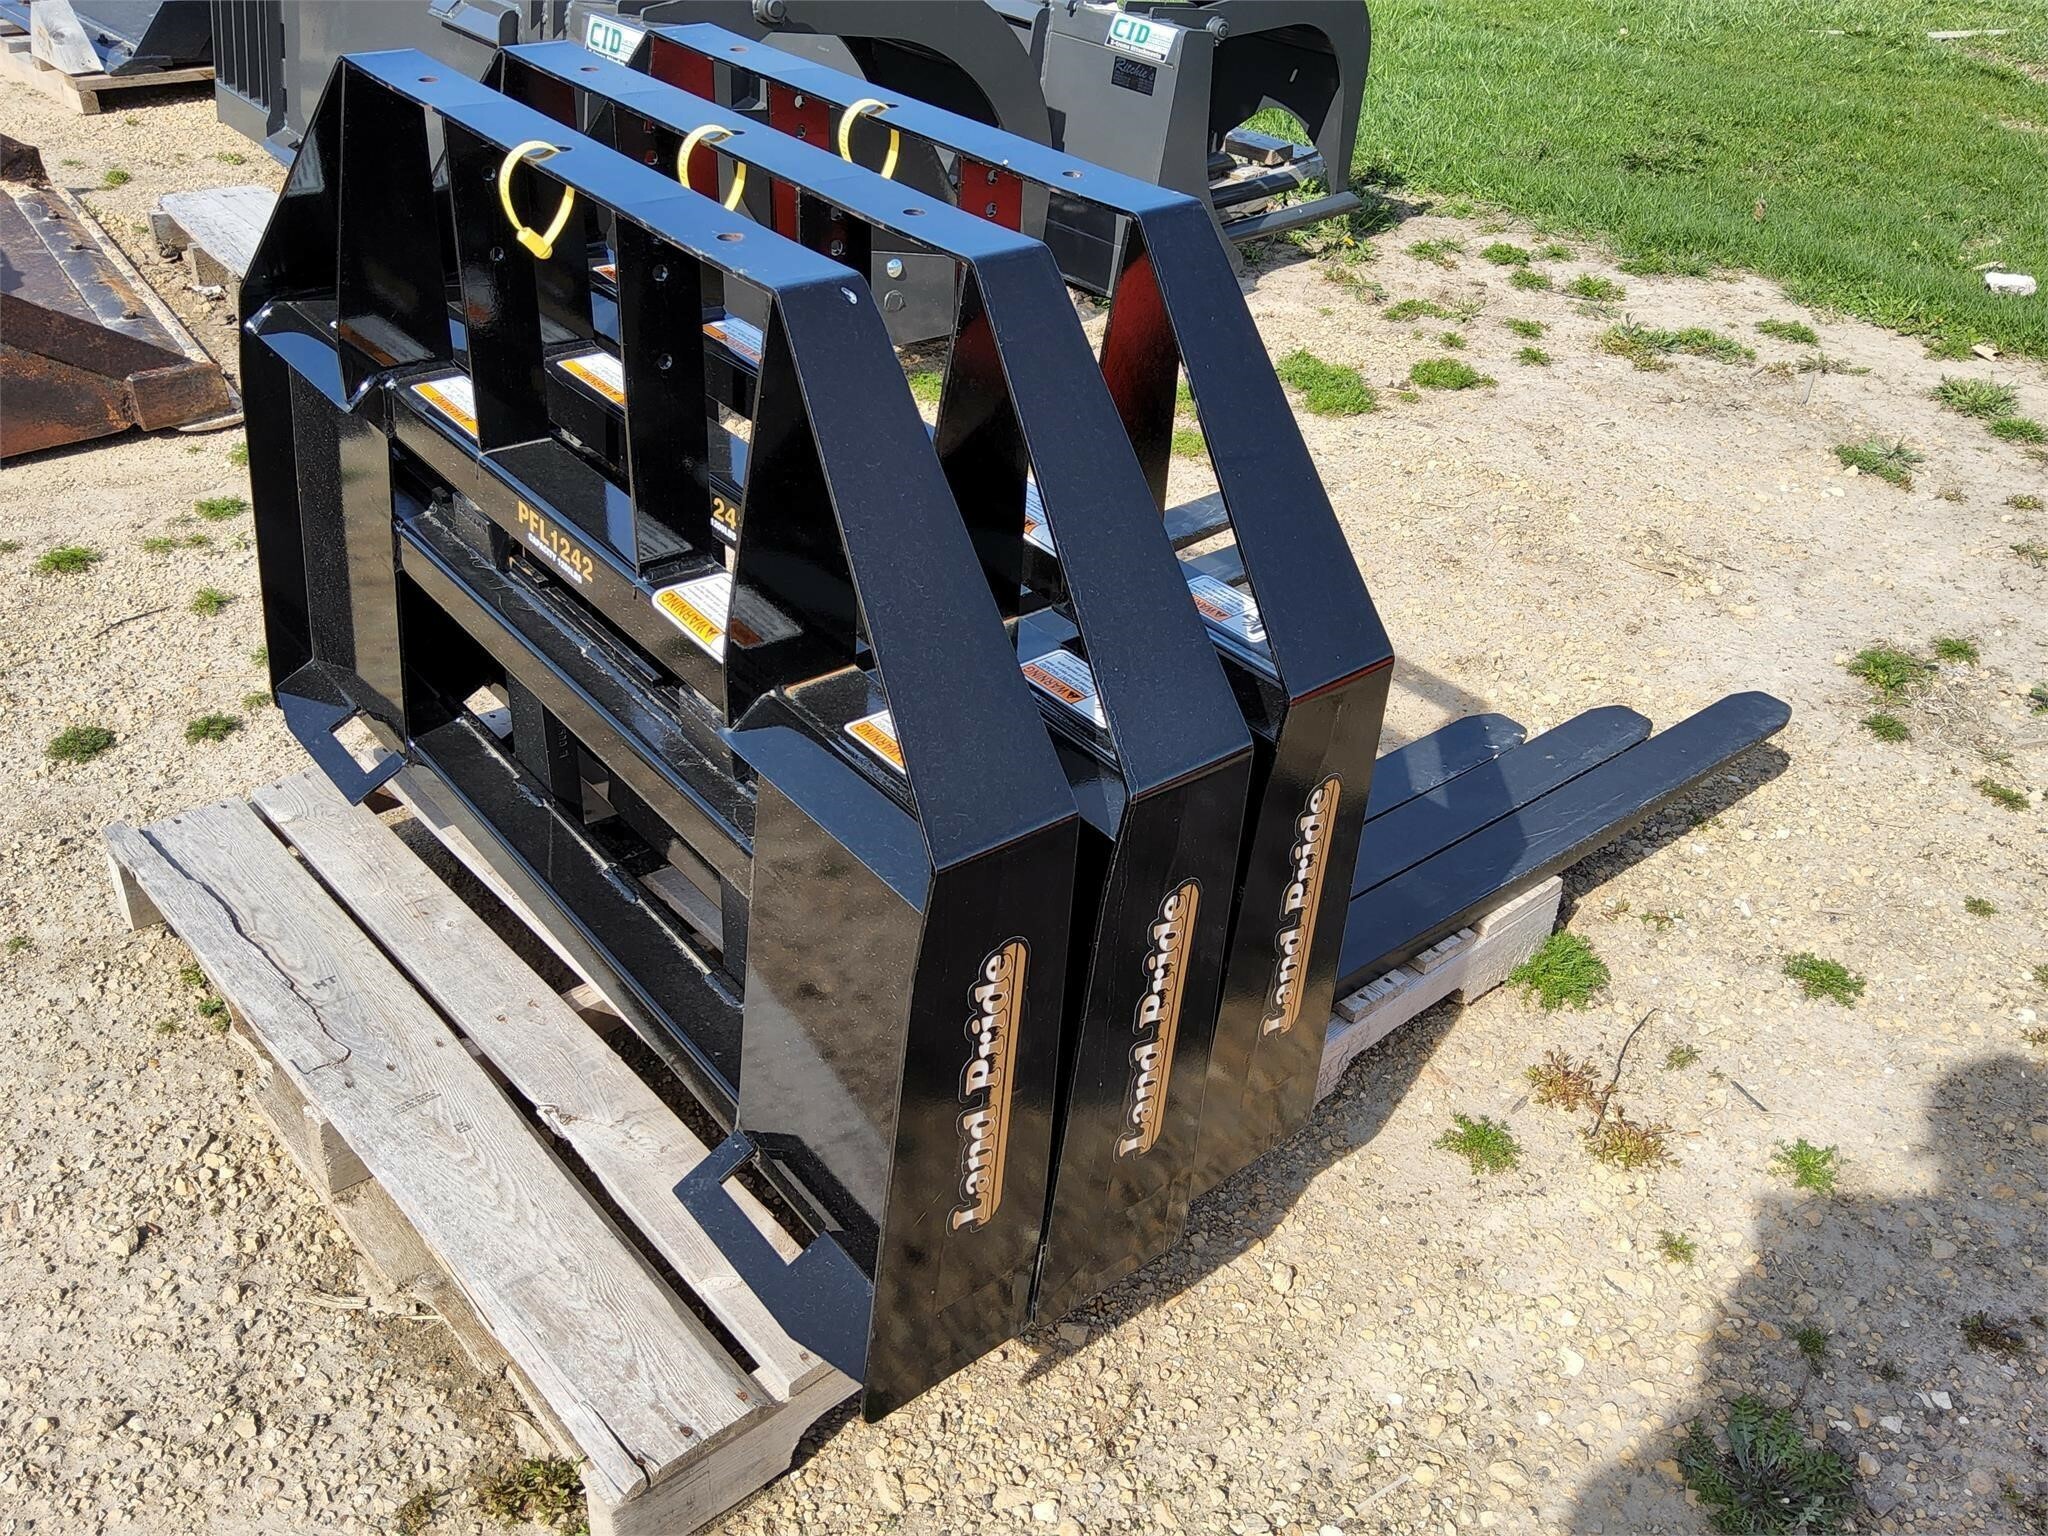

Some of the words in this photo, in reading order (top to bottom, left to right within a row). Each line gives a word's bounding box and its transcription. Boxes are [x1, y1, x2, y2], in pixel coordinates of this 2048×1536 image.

[590, 22, 622, 54] CID
[1113, 19, 1150, 43] CID
[518, 499, 593, 583] PFL1242
[661, 591, 709, 634] WARNING
[1023, 665, 1070, 694] WARNING
[1139, 893, 1187, 1029] Pride
[1263, 925, 1305, 1037] Land
[1285, 787, 1330, 915] Pride
[966, 953, 1013, 1096] Pride
[1119, 1037, 1165, 1157] Land
[953, 1103, 998, 1230] Land
